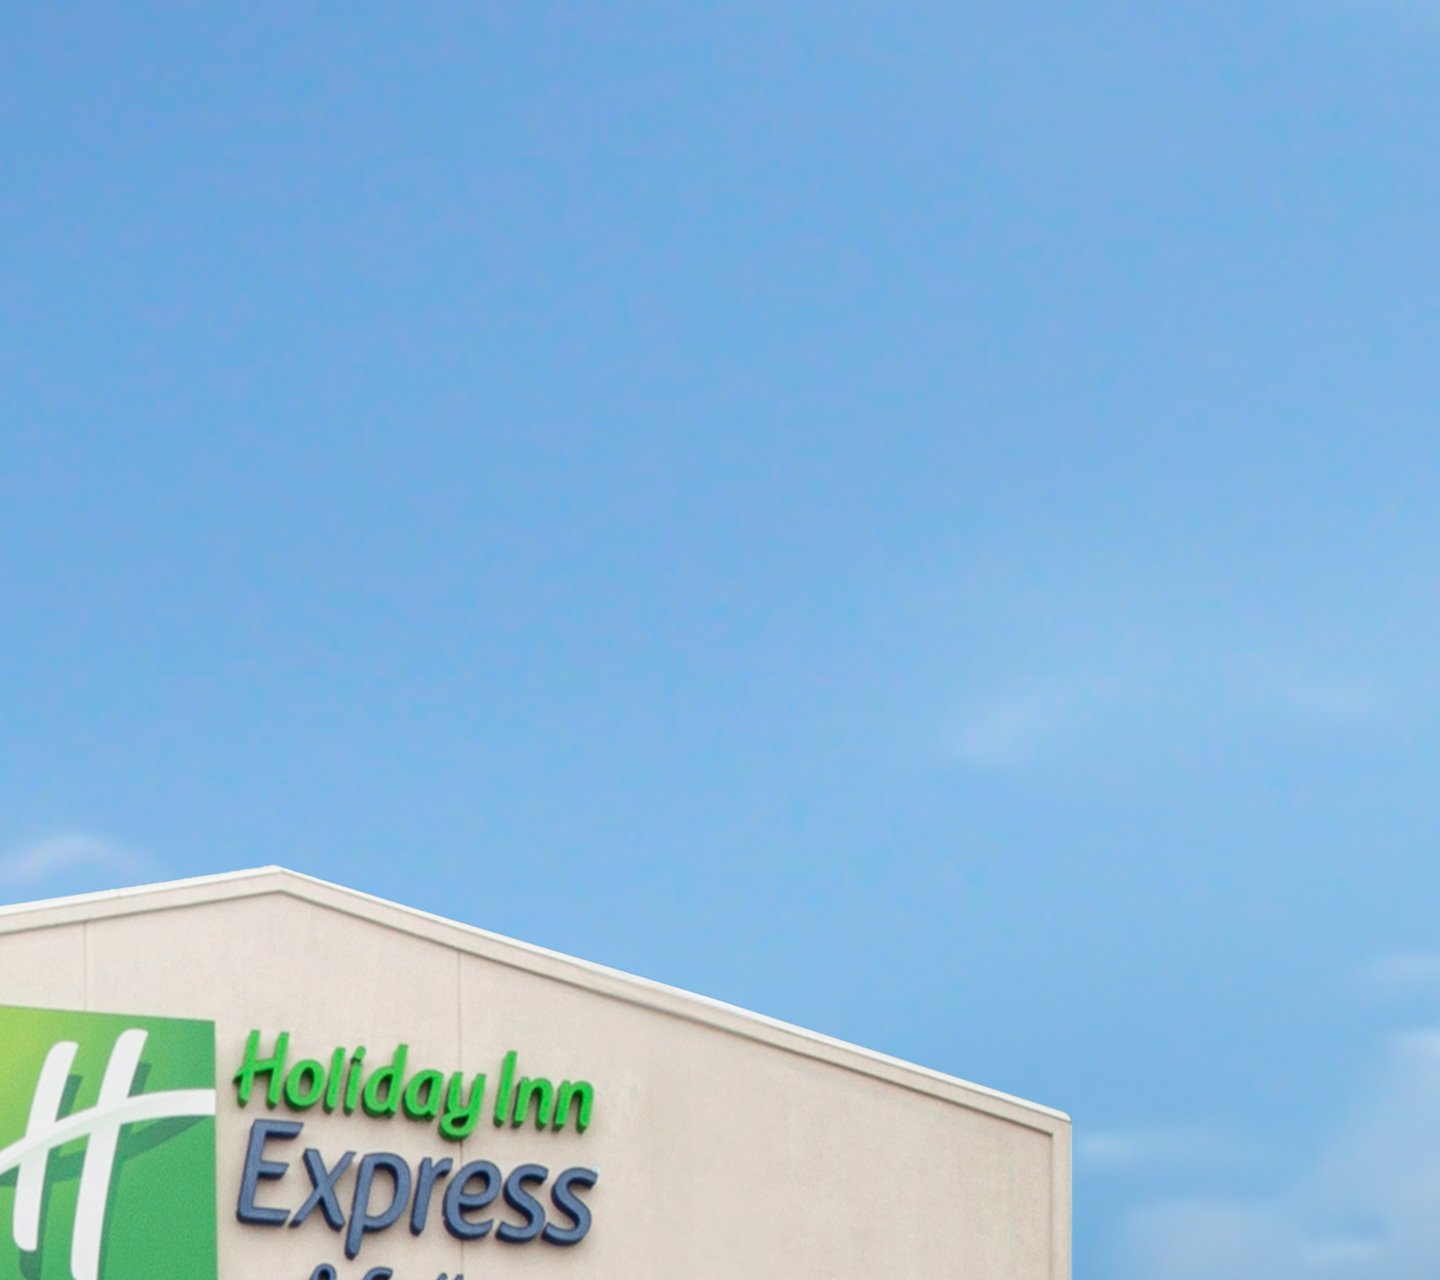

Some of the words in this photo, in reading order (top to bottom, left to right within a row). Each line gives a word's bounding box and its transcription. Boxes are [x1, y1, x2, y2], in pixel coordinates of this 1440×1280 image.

[233, 1029, 486, 1141] Holiday
[493, 1050, 595, 1133] Inn
[235, 1118, 600, 1259] Express
